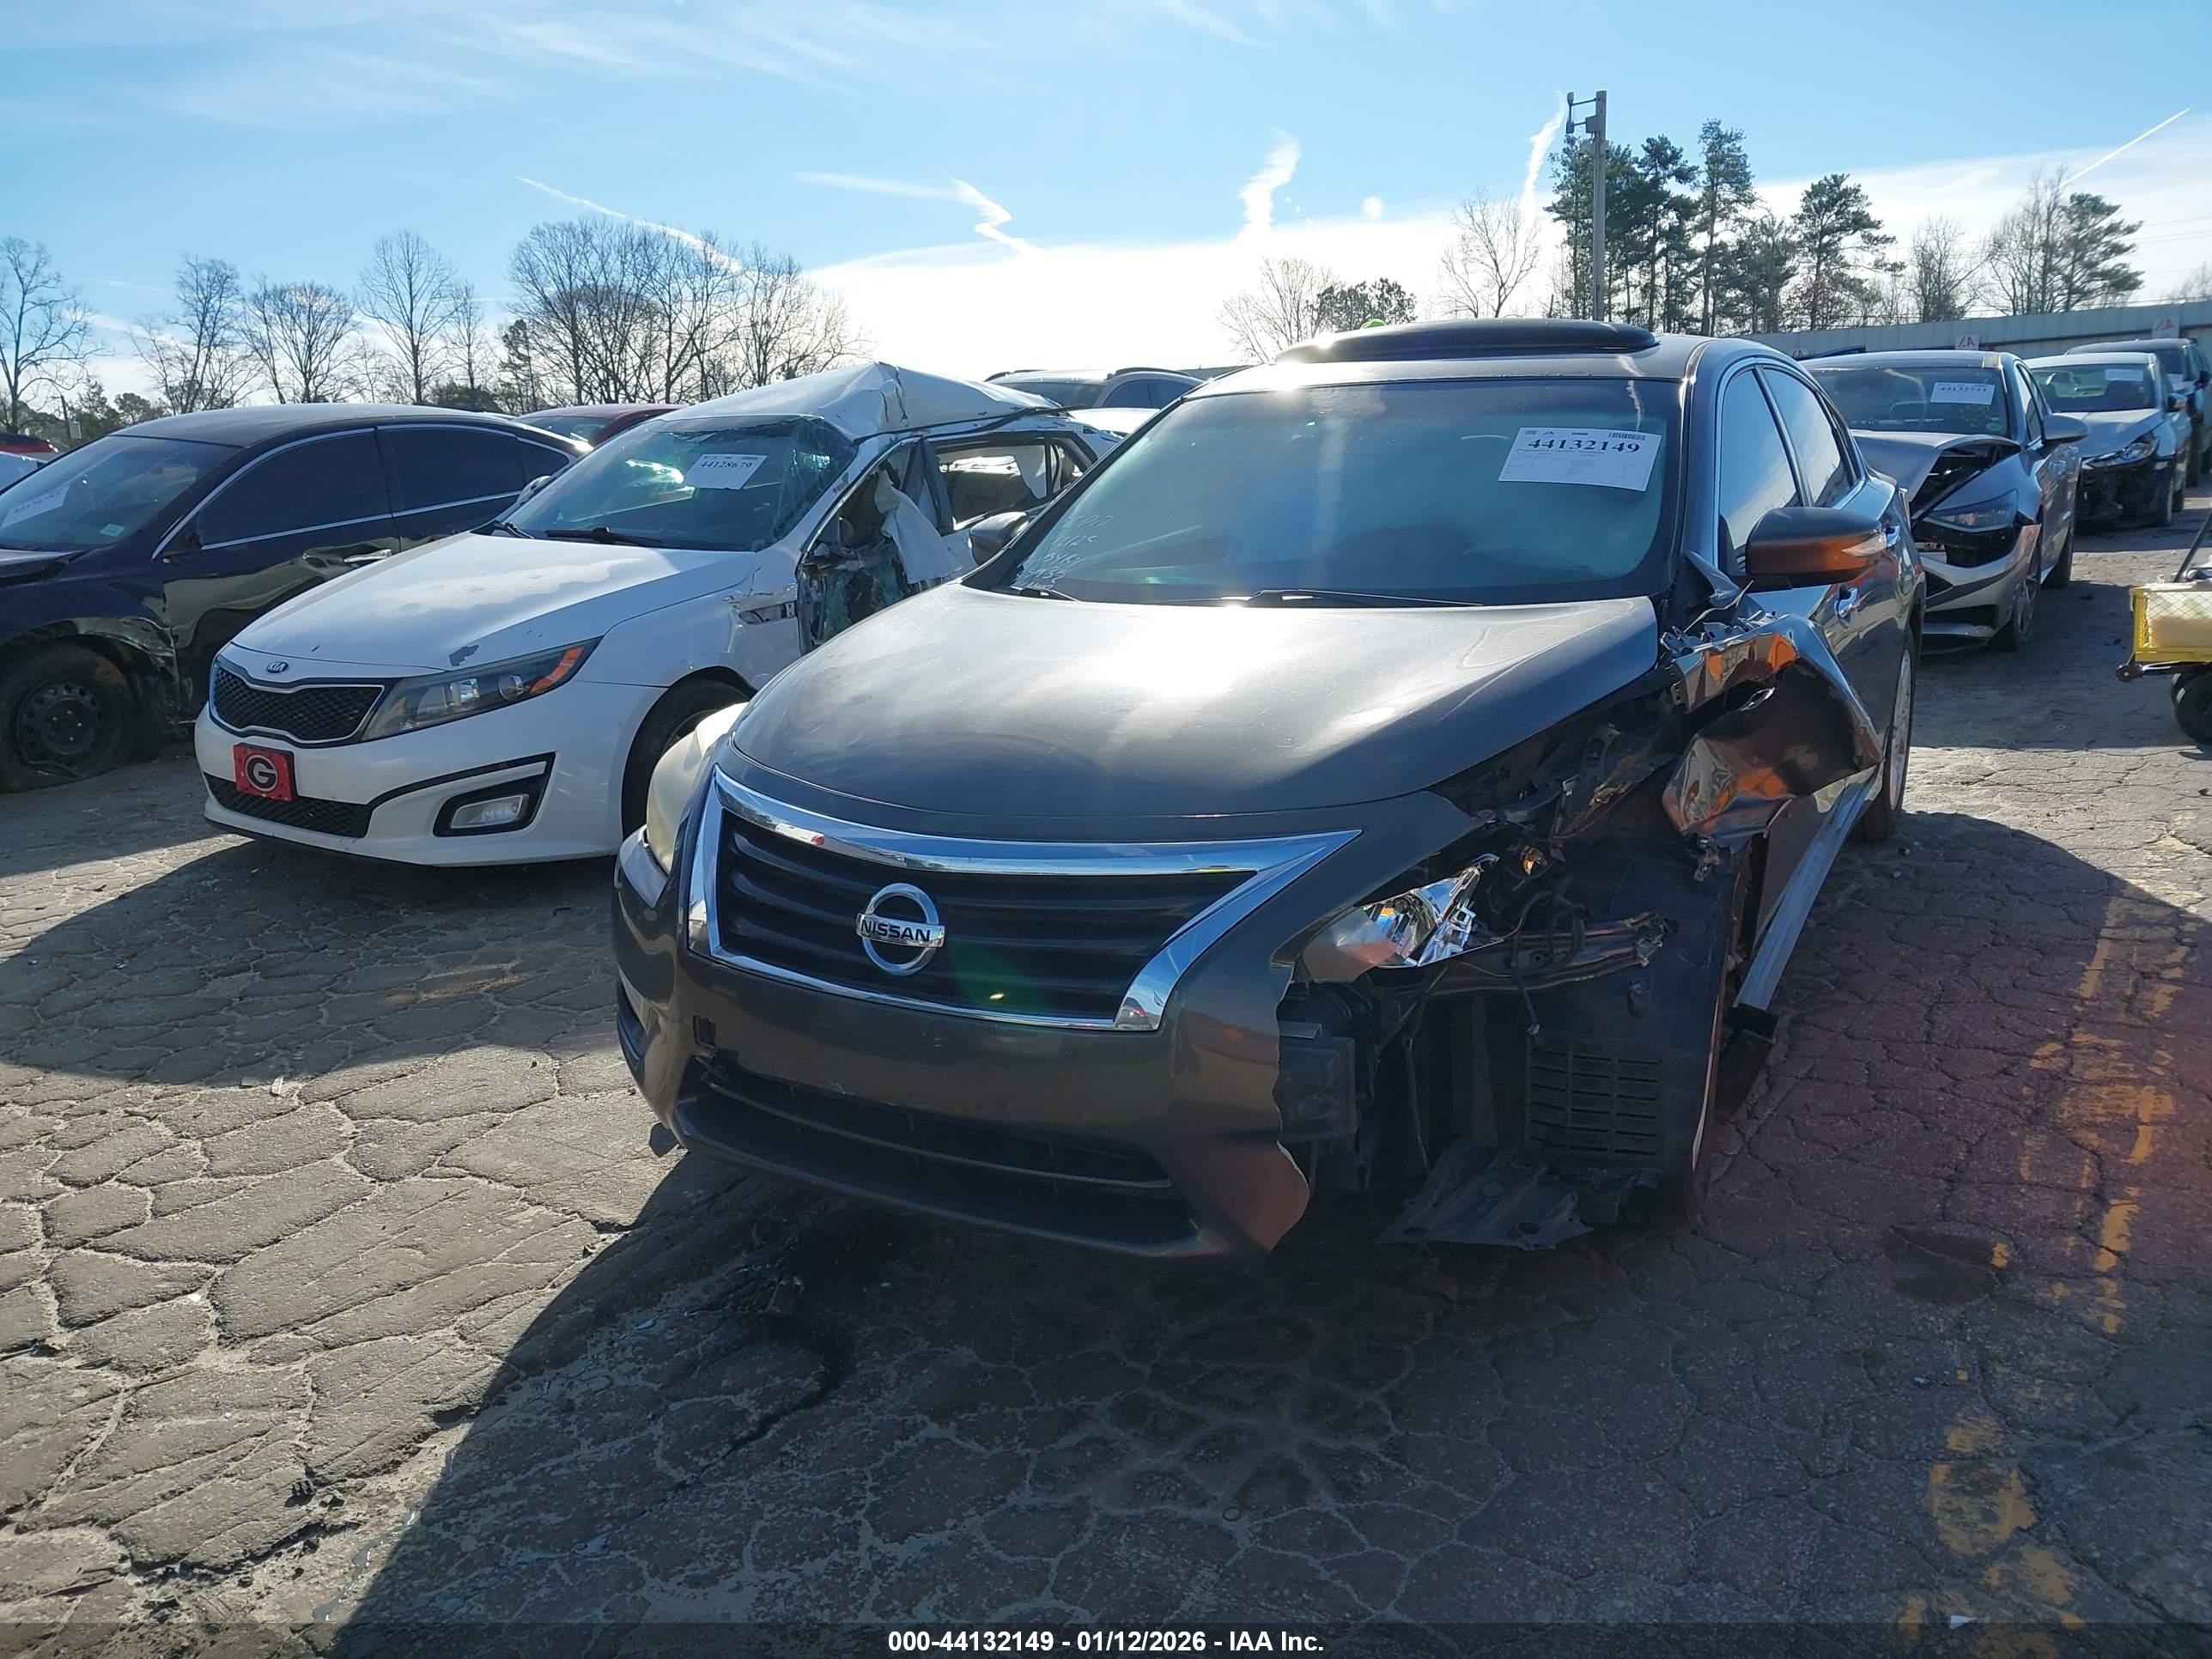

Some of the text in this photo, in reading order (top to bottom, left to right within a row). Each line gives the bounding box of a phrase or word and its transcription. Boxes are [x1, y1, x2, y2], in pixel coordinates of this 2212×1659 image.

[1528, 439, 1640, 453] 44132149
[267, 662, 287, 672] KIA
[246, 755, 278, 792] G
[860, 919, 932, 942] NISSAN
